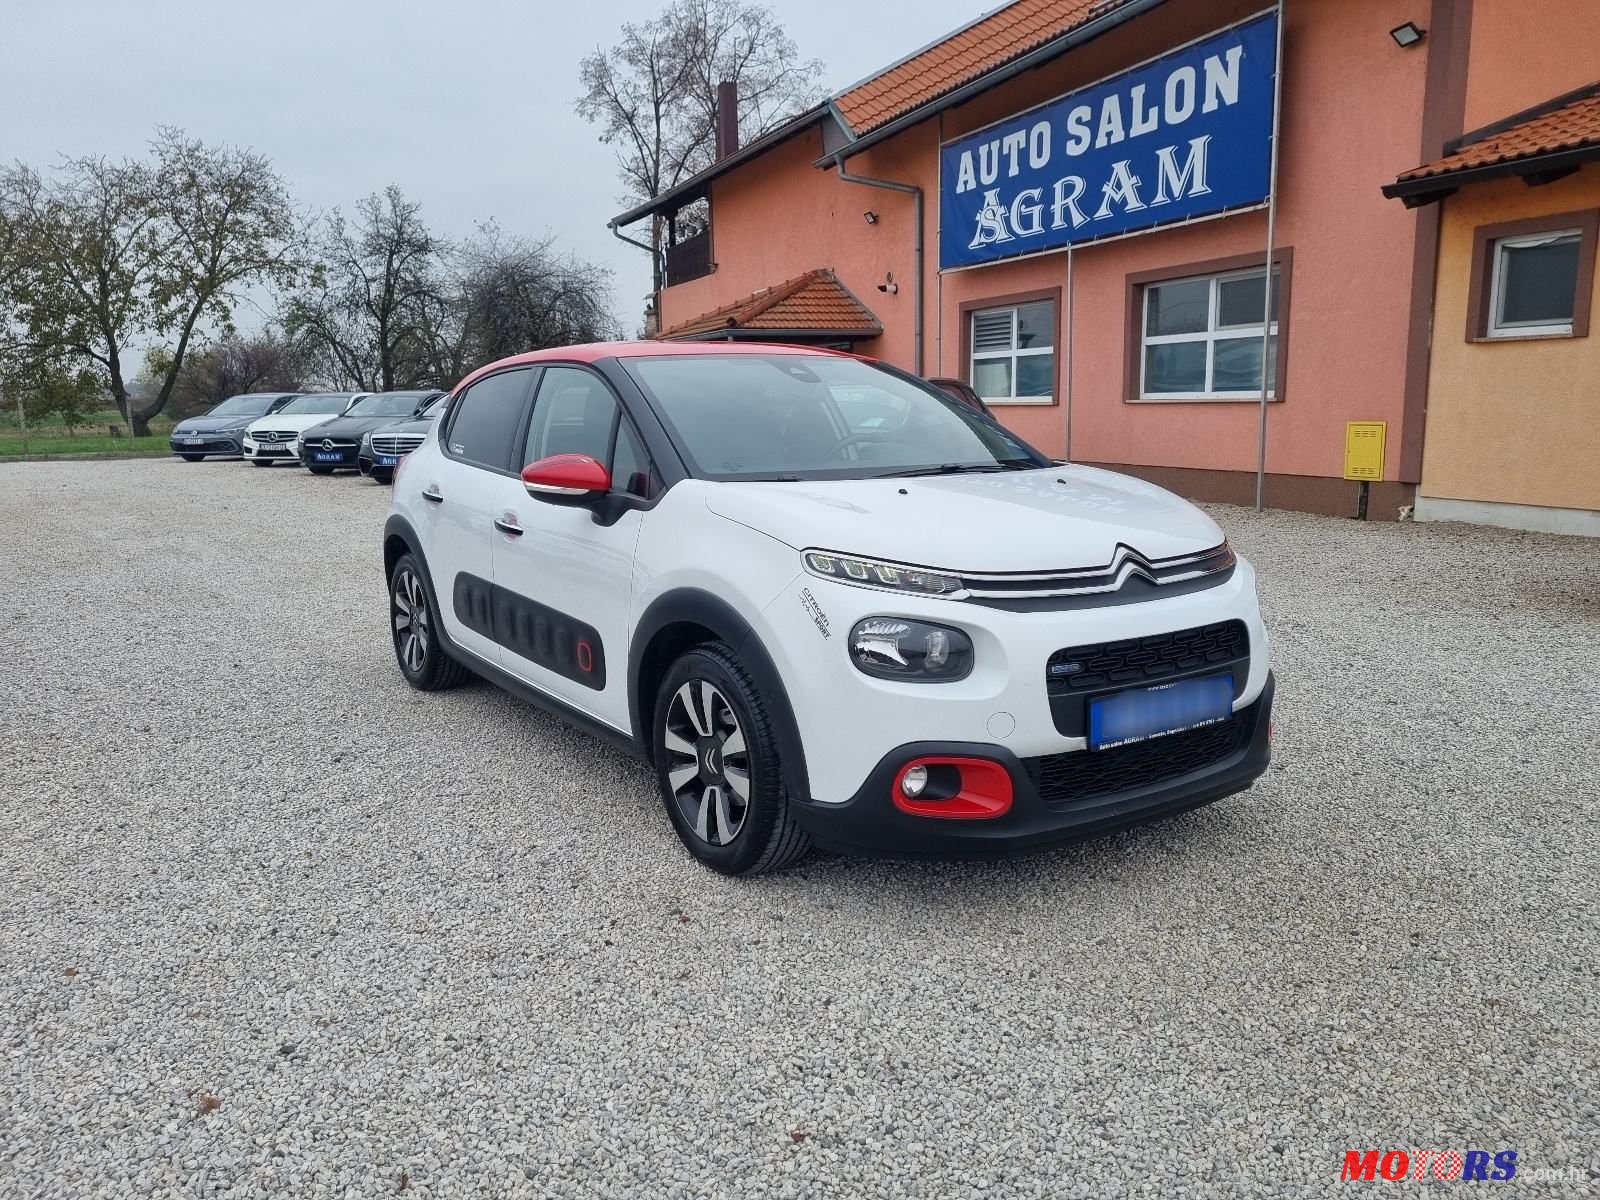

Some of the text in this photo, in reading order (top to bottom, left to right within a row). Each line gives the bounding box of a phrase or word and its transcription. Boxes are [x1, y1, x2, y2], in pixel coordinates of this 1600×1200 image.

[956, 45, 1243, 194] AUTO SALON
[968, 134, 1213, 249] AGRAM
